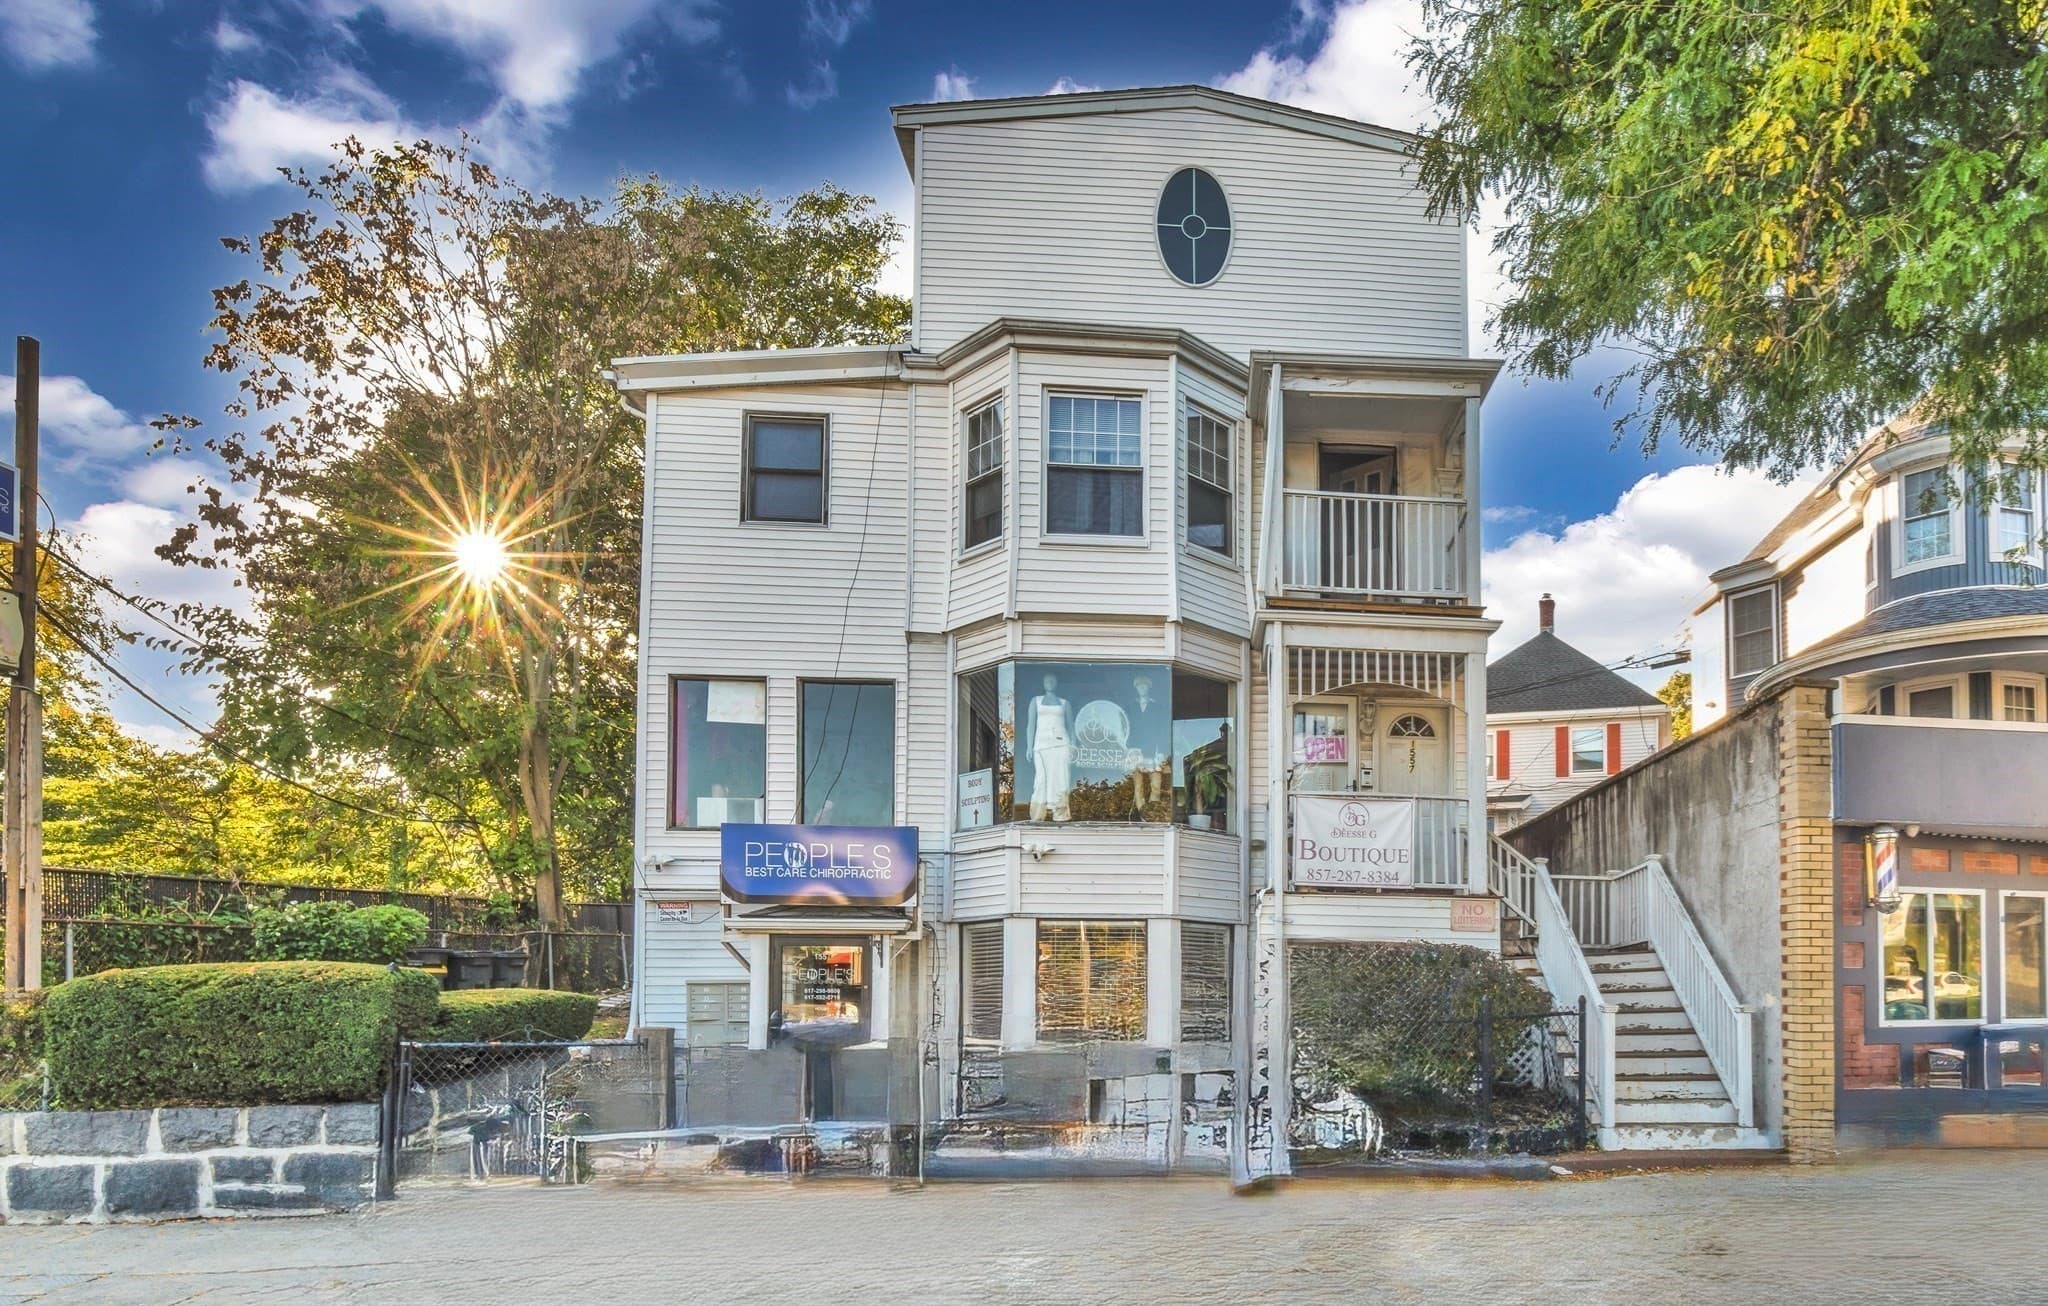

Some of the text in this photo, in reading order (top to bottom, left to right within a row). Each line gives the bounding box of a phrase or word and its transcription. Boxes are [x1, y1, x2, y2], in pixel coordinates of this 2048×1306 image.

[1304, 736, 1345, 760] OPEN
[967, 777, 983, 788] BODY
[961, 794, 991, 807] SCULPTING
[1369, 830, 1377, 839] G
[1299, 839, 1409, 866] BOUTIQUE
[745, 867, 892, 879] BEST CARE CHIROPRACTIC
[1307, 868, 1400, 883] 857-287-8384
[1462, 903, 1484, 915] NO
